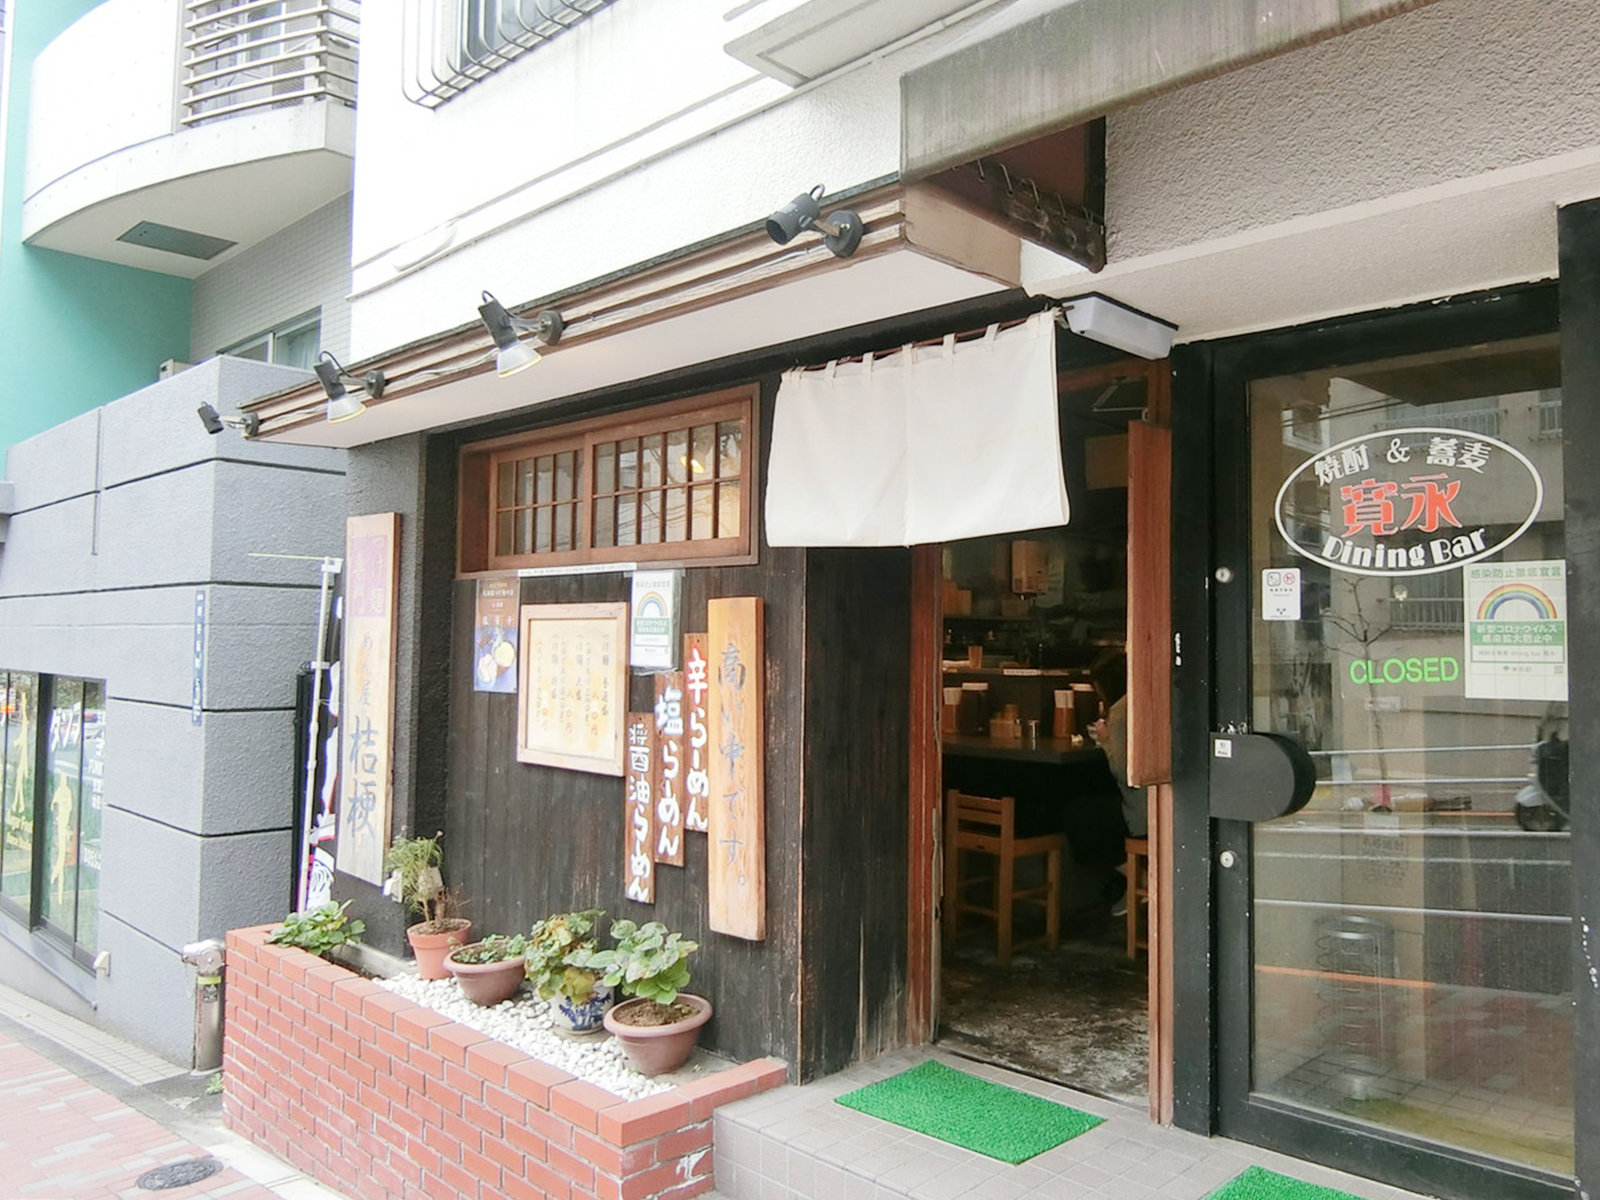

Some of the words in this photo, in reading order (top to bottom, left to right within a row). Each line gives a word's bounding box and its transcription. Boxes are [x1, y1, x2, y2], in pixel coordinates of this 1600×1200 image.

[1314, 443, 1369, 487] 焼酎
[1386, 437, 1411, 463] &
[1426, 436, 1492, 474] 蕎麦
[1321, 535, 1425, 568] Dining
[1429, 528, 1487, 565] Bar
[1349, 656, 1460, 684] CLOSED
[655, 685, 684, 857] 塩らーめん
[687, 648, 709, 829] 辛らーめん
[629, 723, 651, 902] 醤油らーめん
